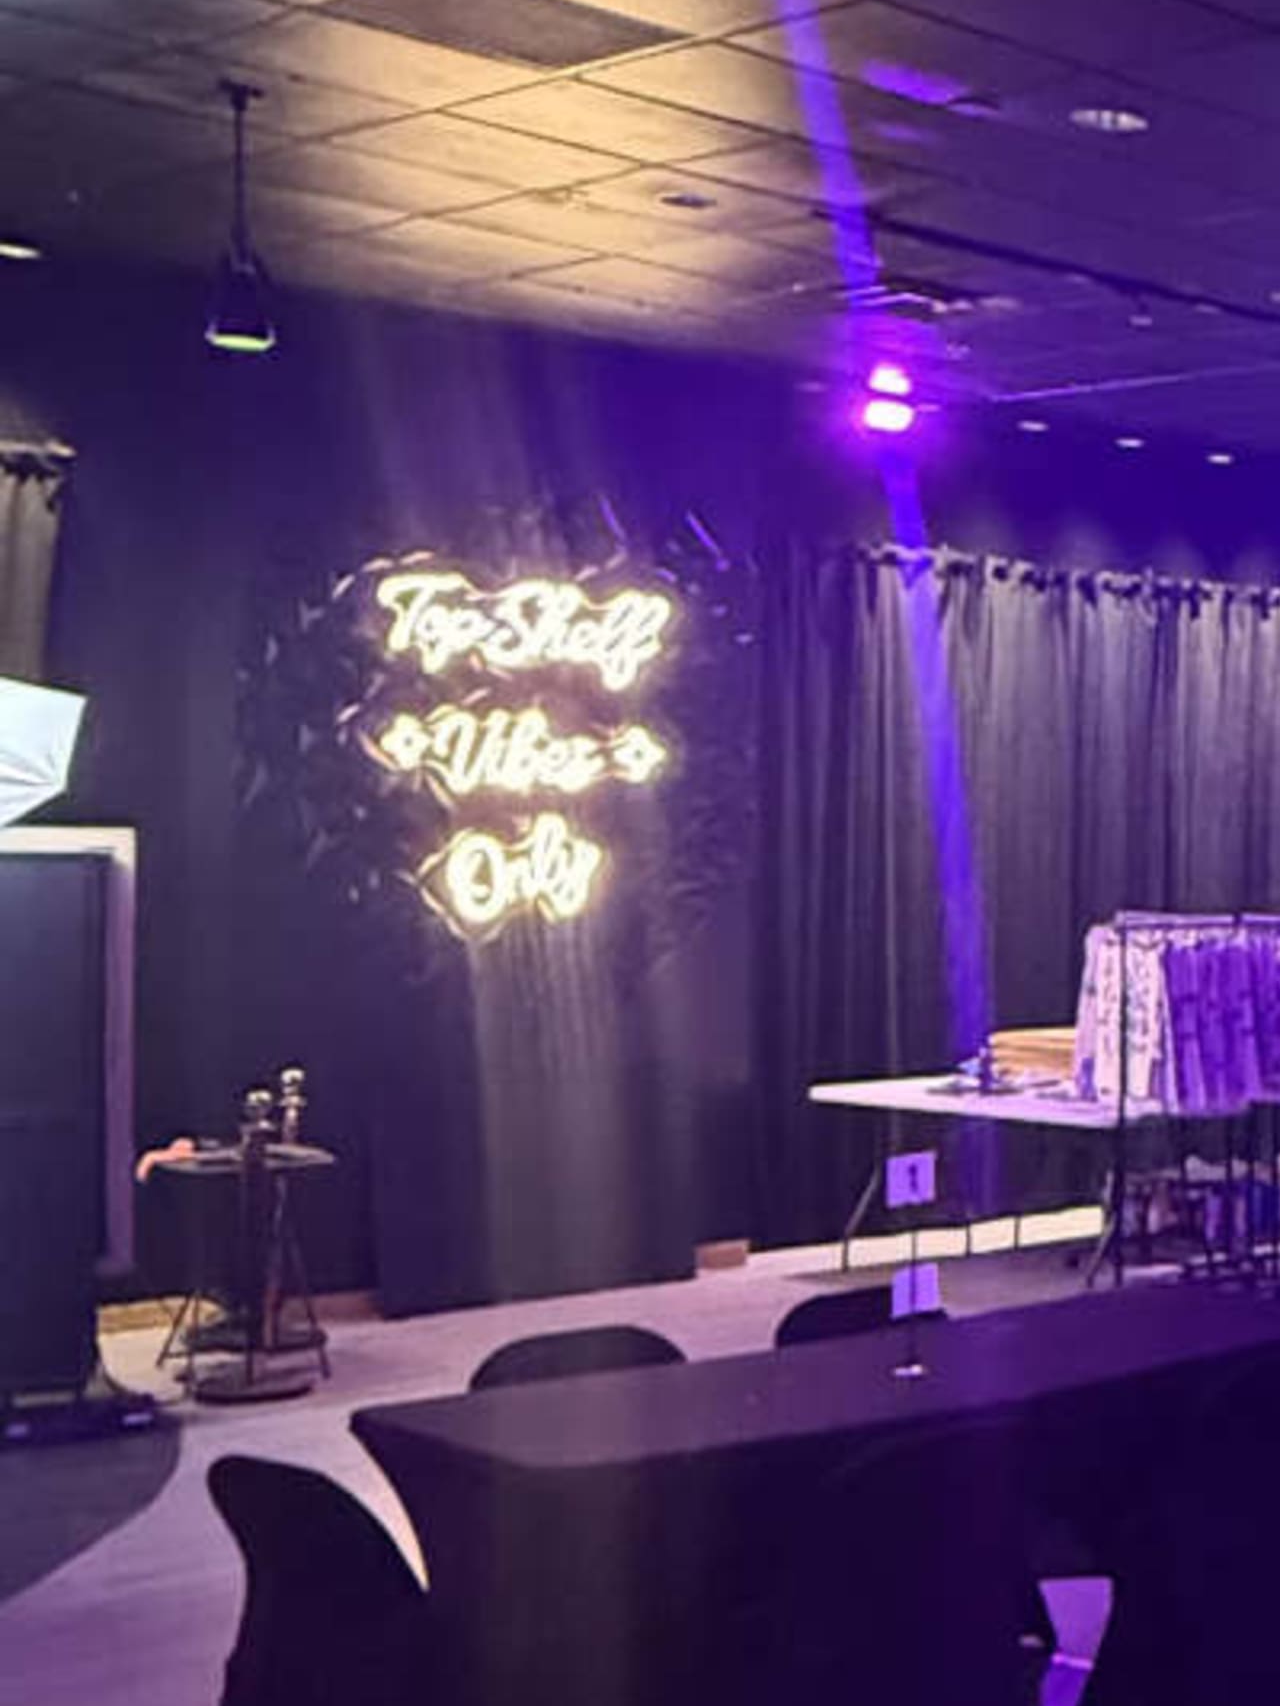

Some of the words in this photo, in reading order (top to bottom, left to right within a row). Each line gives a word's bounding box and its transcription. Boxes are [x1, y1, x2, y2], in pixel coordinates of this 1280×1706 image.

[376, 573, 494, 674] Top
[480, 579, 671, 691] Shelf
[432, 706, 605, 794] Vibes
[445, 811, 603, 924] Only
